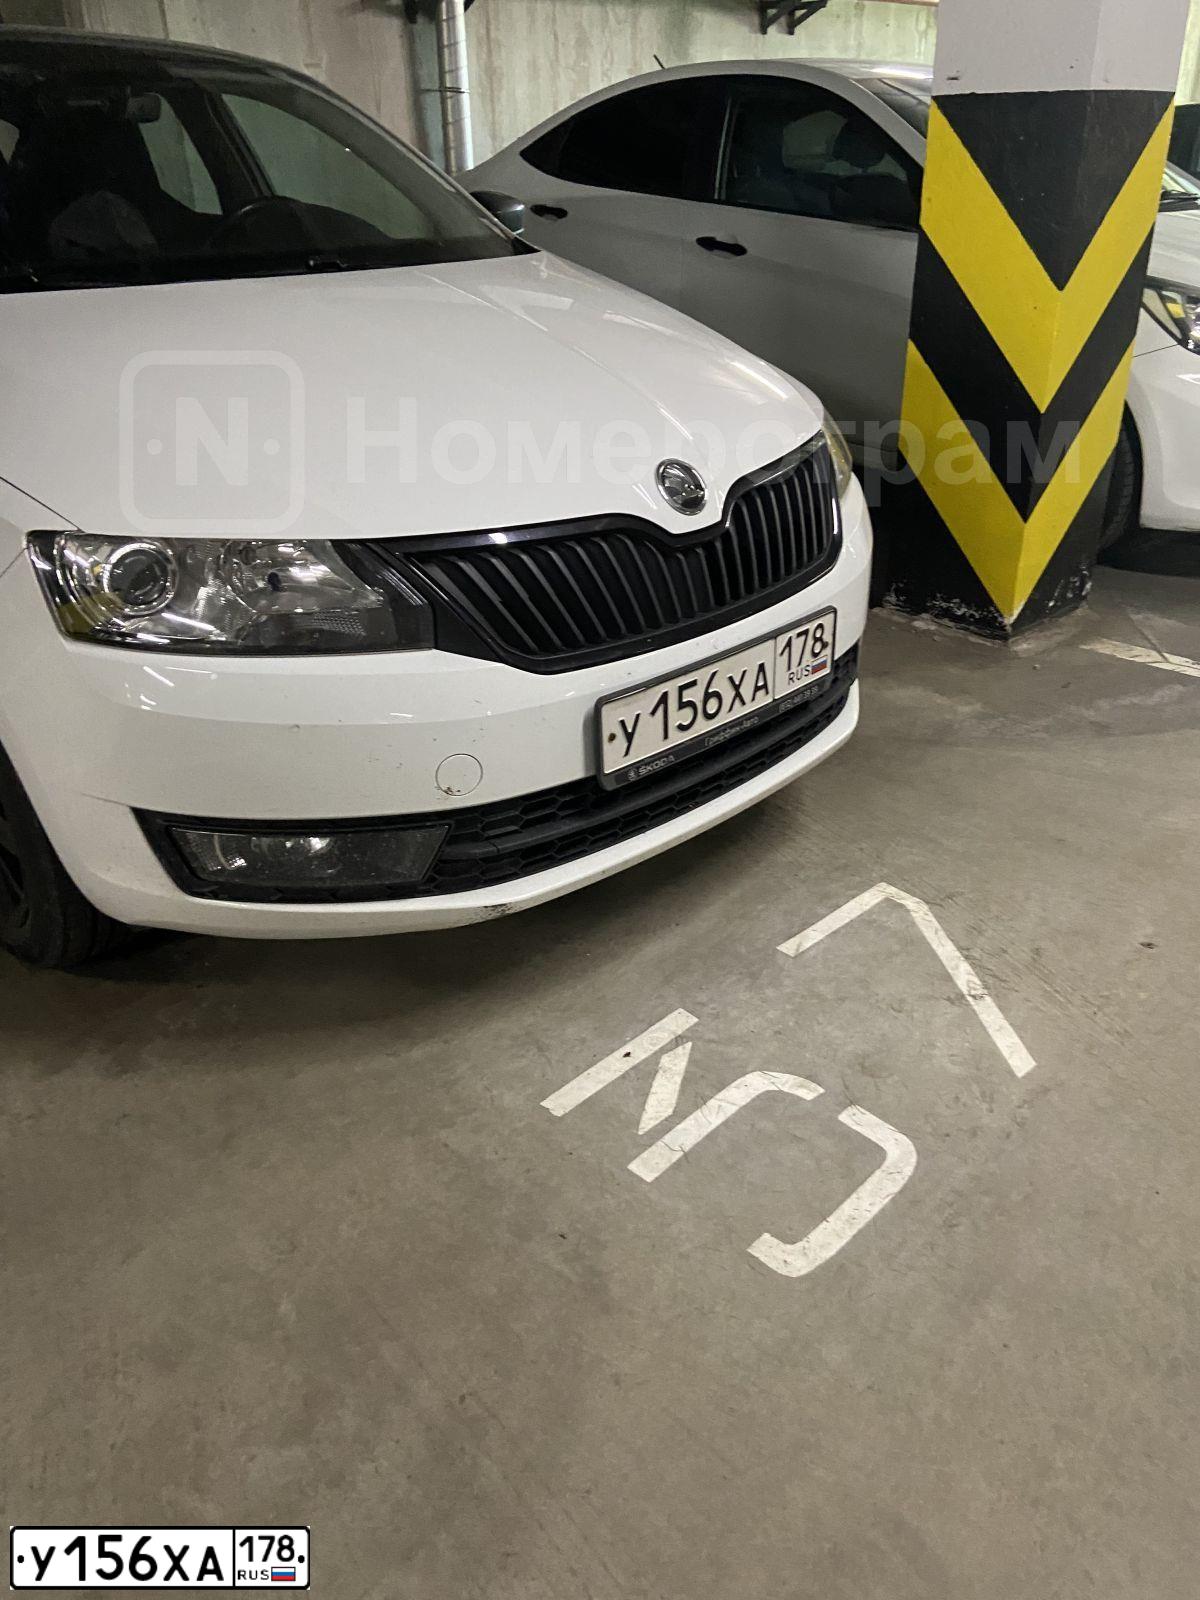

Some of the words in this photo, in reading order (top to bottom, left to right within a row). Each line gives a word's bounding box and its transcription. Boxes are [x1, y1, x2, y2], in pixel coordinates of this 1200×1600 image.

[779, 622, 825, 672] 178
[787, 667, 811, 687] RUS
[618, 662, 769, 758] У156ХА
